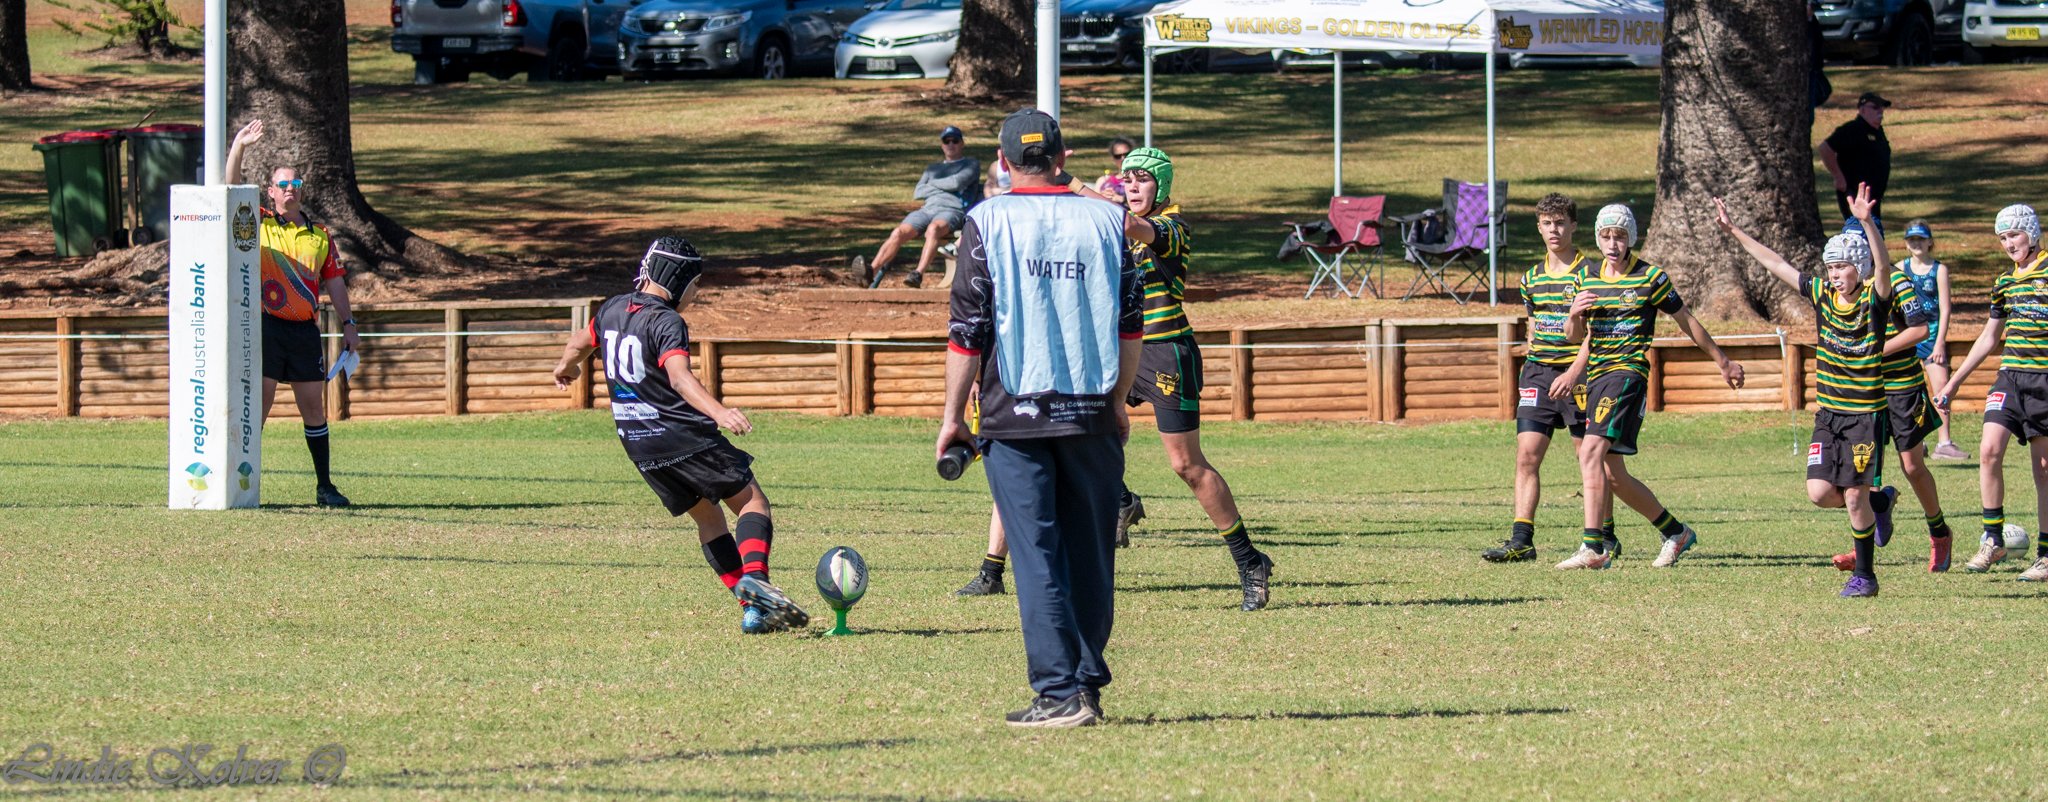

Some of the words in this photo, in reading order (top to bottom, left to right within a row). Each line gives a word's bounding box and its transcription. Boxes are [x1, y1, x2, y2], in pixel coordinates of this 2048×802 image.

[1225, 17, 1302, 34] VIKINGS
[1323, 18, 1404, 38] GOLDEN
[1410, 21, 1482, 39] OLDIES
[1539, 18, 1620, 44] WRINKLED
[1623, 20, 1663, 46] HORN
[179, 214, 222, 222] INTERSPORT
[1026, 258, 1086, 281] WATER
[604, 330, 646, 384] 10
[1049, 401, 1066, 411] Big
